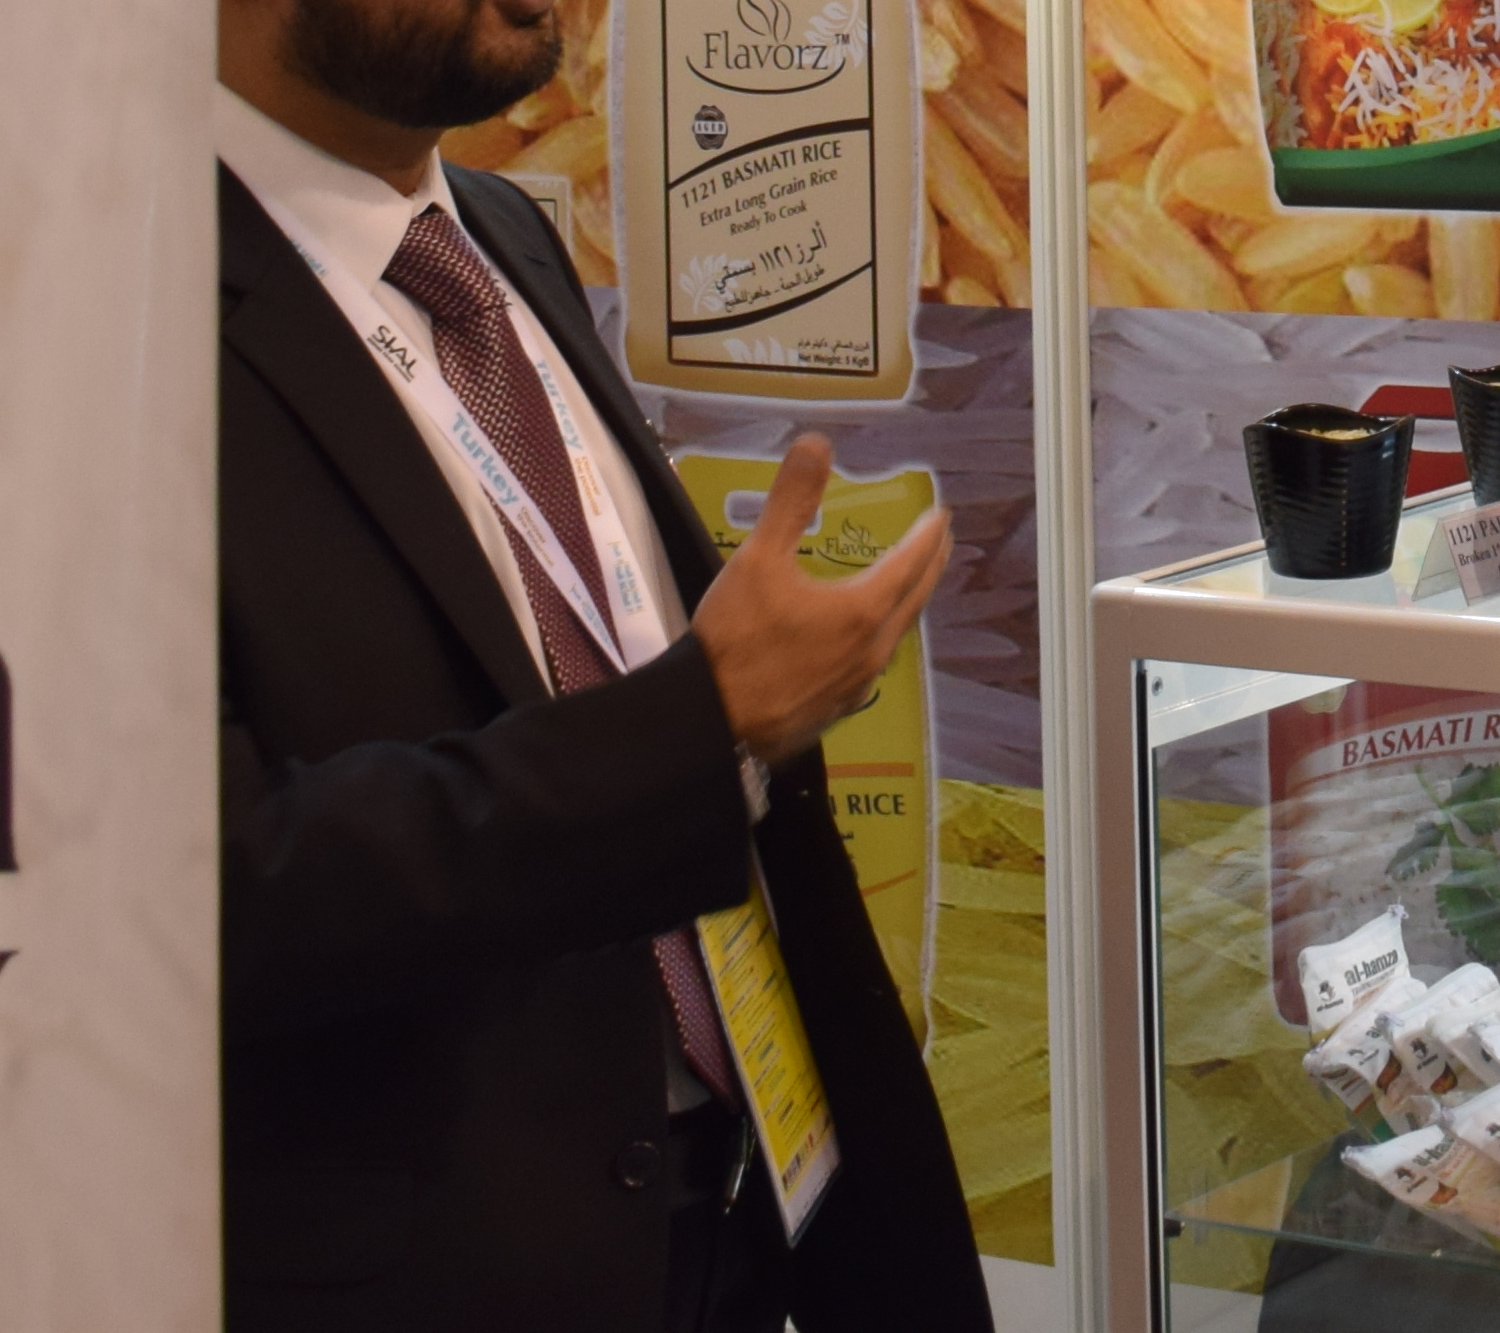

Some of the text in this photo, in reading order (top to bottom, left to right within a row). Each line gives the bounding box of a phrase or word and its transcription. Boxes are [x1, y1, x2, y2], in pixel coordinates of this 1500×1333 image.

[703, 30, 828, 70] Flavorz
[681, 140, 843, 208] 1121 BASMATI RICE
[700, 168, 838, 226] Extra Long Grain Rice
[730, 200, 808, 236] Ready To Cook
[451, 411, 520, 507] Turkey
[1449, 523, 1477, 546] 1121
[1458, 549, 1491, 567] Broken
[1342, 717, 1476, 768] BASMATI
[847, 792, 907, 816] RICE
[1344, 948, 1399, 987] al-hamza
